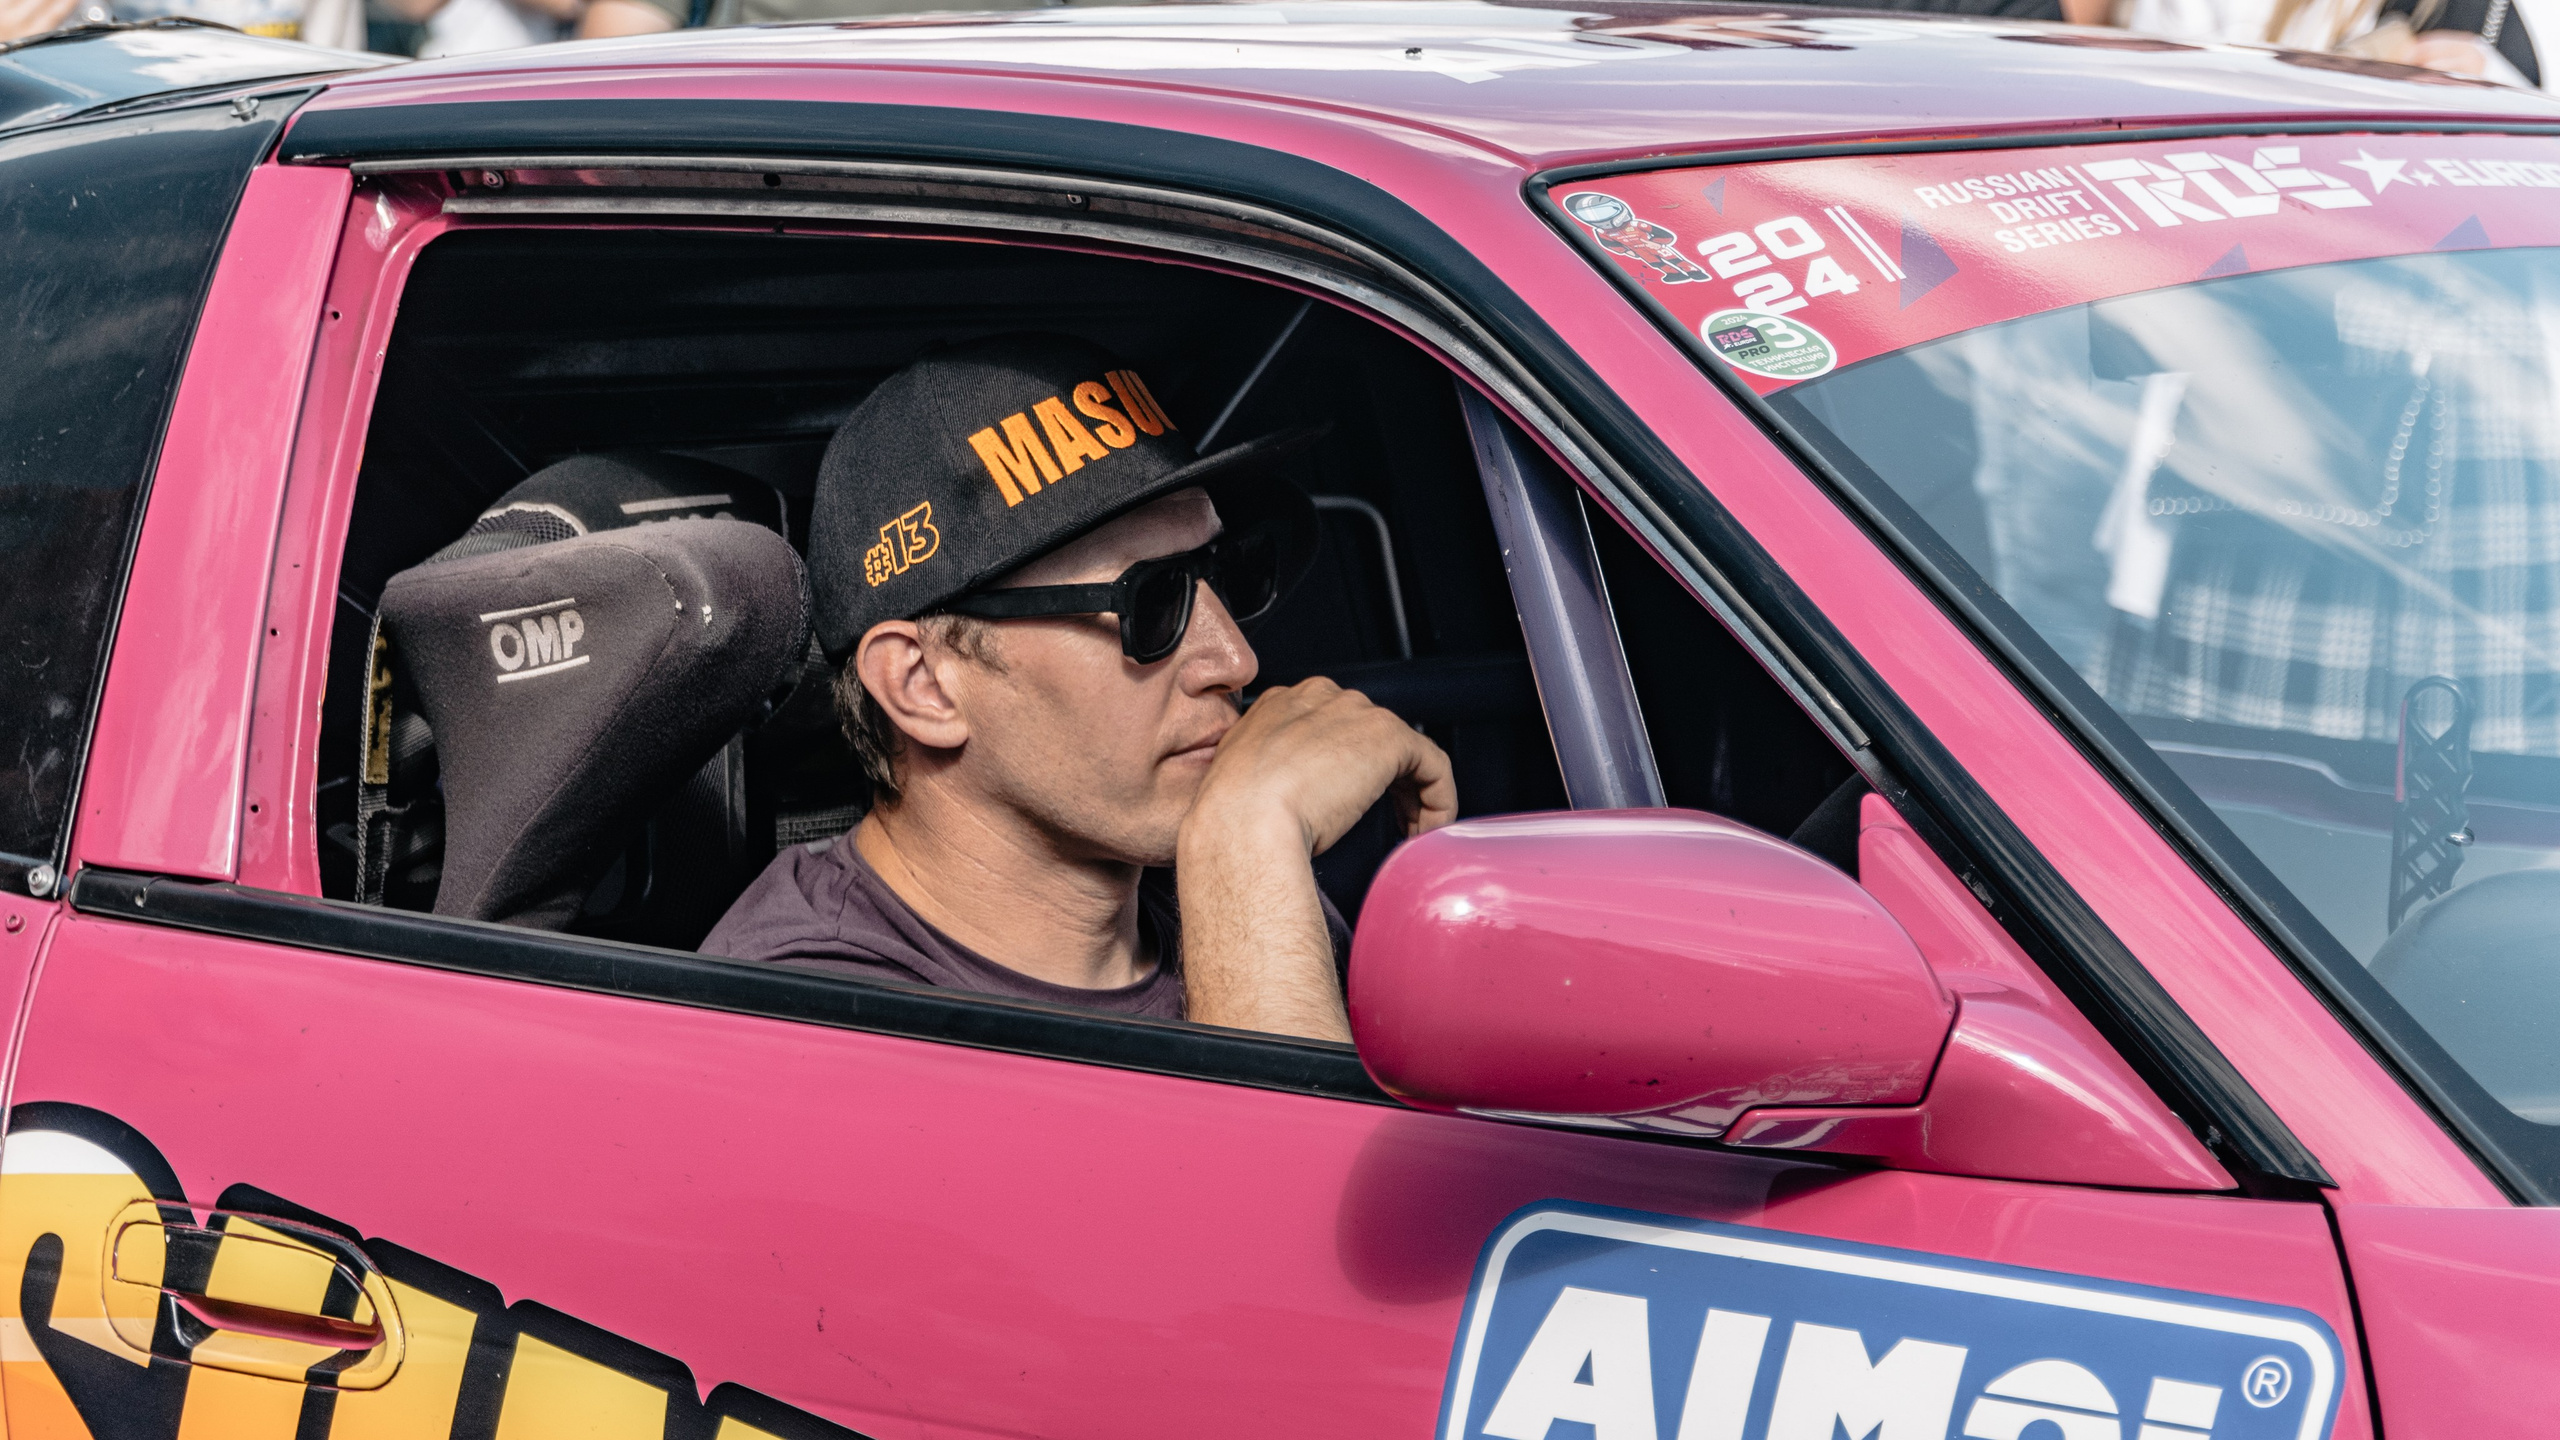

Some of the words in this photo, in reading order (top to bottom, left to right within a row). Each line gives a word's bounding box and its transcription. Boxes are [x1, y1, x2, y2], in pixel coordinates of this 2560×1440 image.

[1914, 167, 2074, 209] RUSSIAN
[2080, 146, 2373, 228] RDS
[1987, 189, 2093, 225] DRIFT
[1697, 215, 1826, 279] 20
[1994, 213, 2122, 253] SERIES
[1733, 255, 1861, 315] 24
[1715, 328, 1755, 346] RDS
[1721, 315, 1749, 326] 2024
[1746, 317, 1807, 348] 3
[1735, 338, 1758, 348] EUROPE
[1738, 345, 1771, 360] PRO
[1748, 345, 1823, 367] ТЕХНИЧЕСКАЯ
[1763, 352, 1827, 372] ИНСПЕКЦИЯ
[864, 500, 940, 587] #13
[490, 609, 585, 672] OMP
